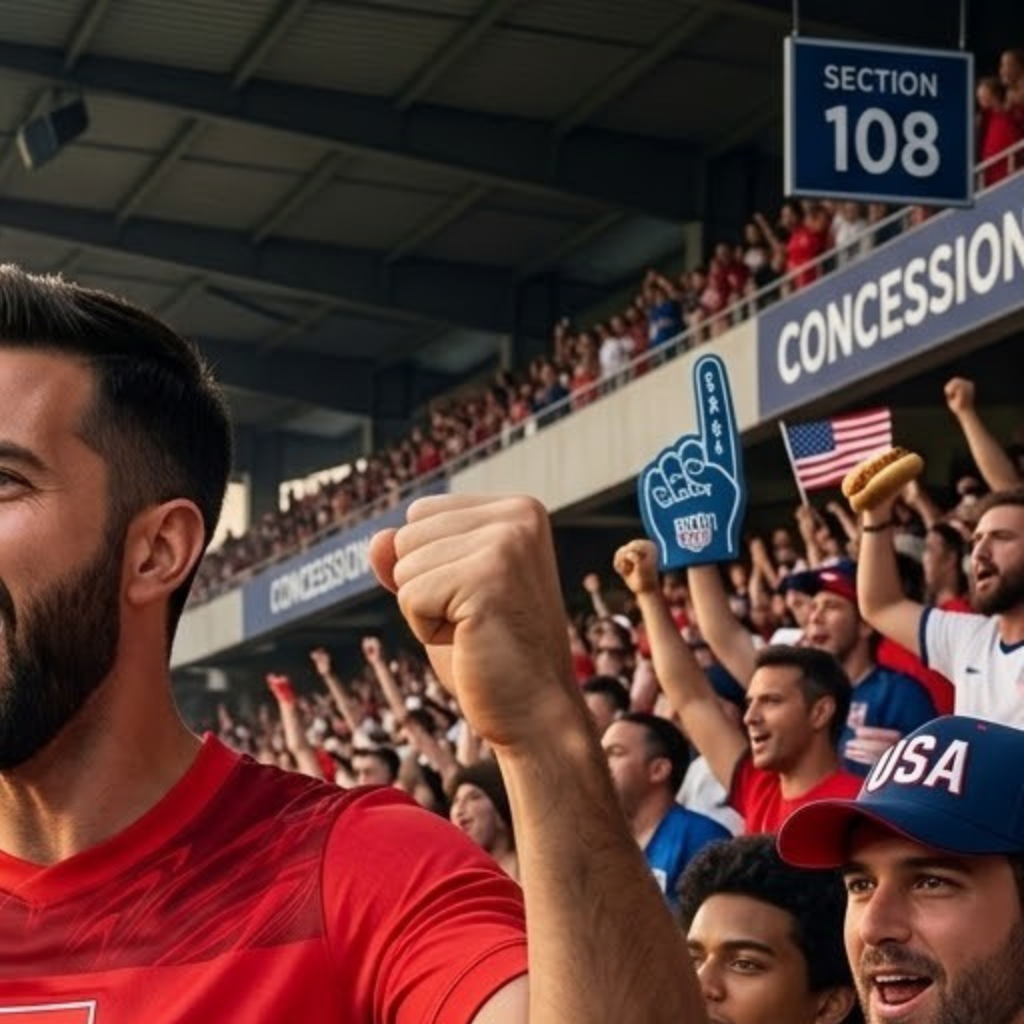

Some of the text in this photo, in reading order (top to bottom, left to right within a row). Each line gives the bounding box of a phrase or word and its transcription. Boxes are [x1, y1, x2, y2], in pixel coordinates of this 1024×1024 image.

[823, 64, 938, 98] SECTION
[824, 105, 941, 178] 108
[866, 734, 970, 795] USA
